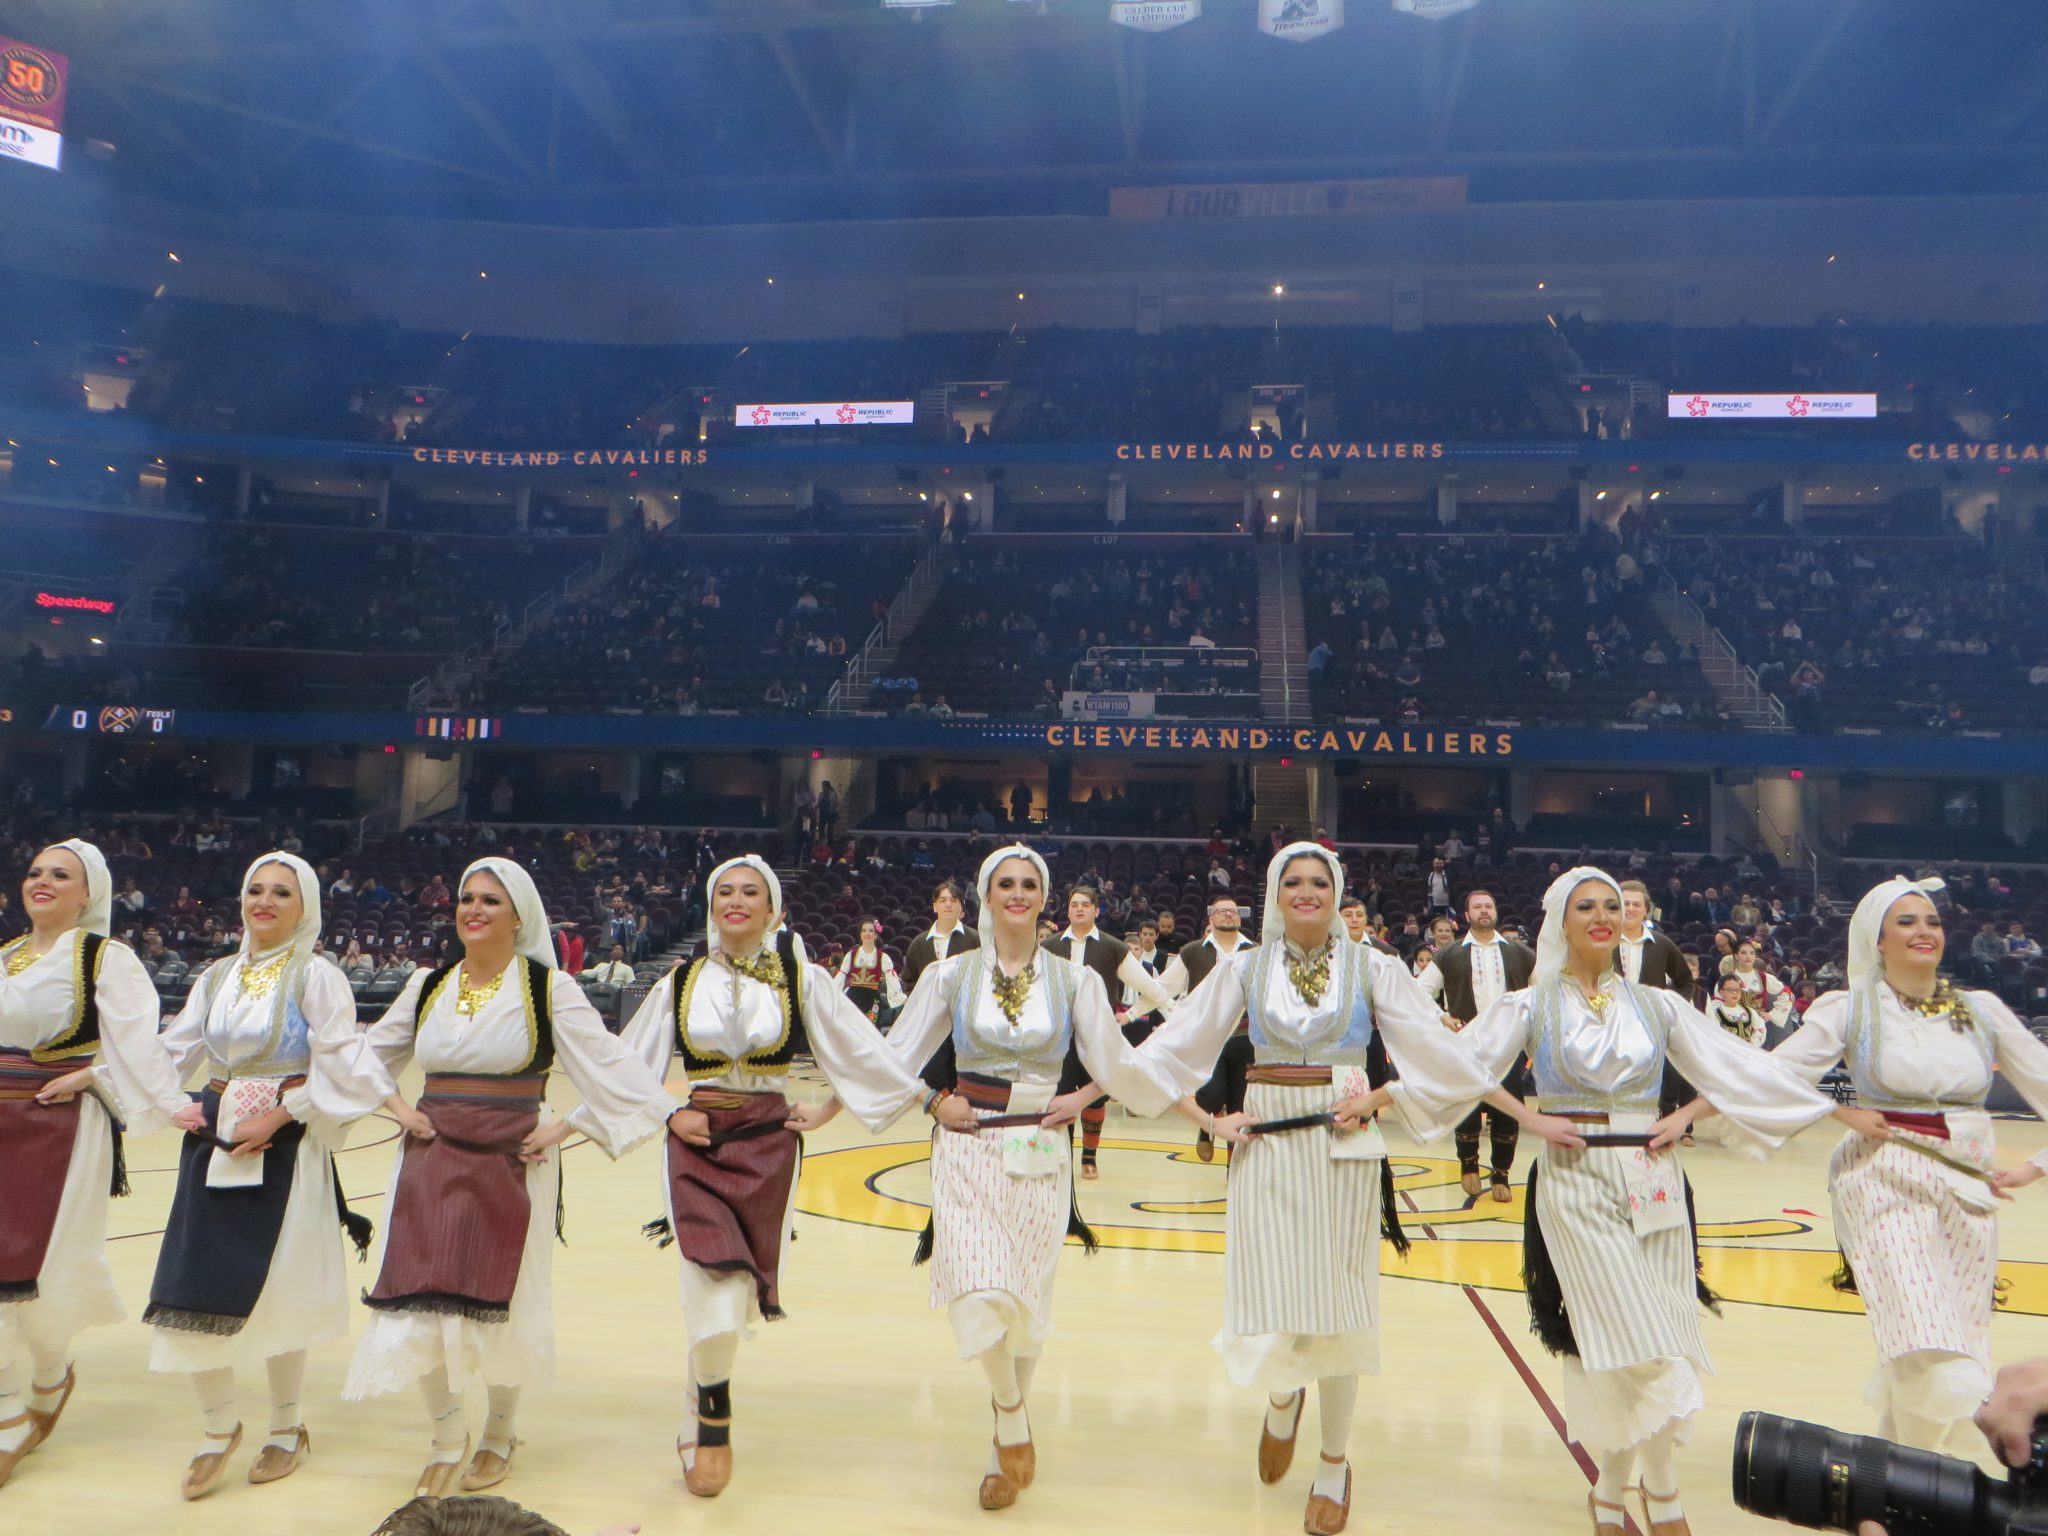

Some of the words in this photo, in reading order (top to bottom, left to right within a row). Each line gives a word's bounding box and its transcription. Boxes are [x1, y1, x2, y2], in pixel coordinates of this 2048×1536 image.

[1166, 5, 1187, 14] CUP
[8, 60, 45, 93] 50
[413, 447, 560, 466] CLEVELAND
[573, 449, 707, 465] CAVALIERS
[1117, 444, 1273, 460] CLEVELAND
[1290, 443, 1443, 459] CAVALIERS
[1907, 443, 2048, 460] CLEVELA
[35, 592, 116, 613] Speedway
[72, 710, 88, 729] 0
[152, 718, 163, 732] 0
[1046, 726, 1269, 749] CLEVELAND
[1293, 729, 1512, 755] CAVALIERS
